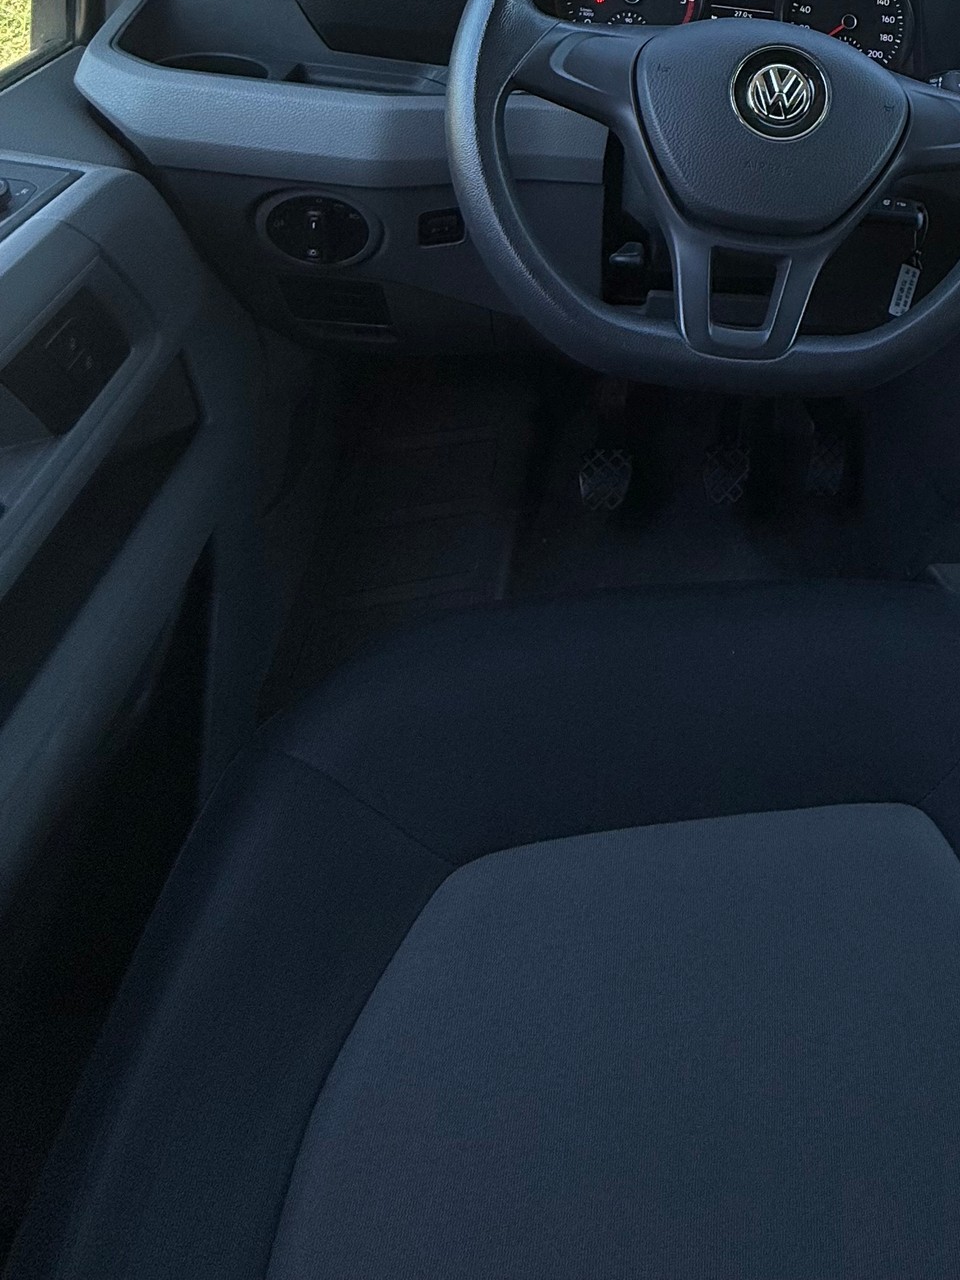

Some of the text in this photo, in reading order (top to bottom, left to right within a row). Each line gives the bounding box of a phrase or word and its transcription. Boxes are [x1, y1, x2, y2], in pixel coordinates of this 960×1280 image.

[799, 5, 811, 13] 40
[881, 15, 895, 24] 160
[880, 34, 893, 42] 180
[867, 50, 883, 59] 200
